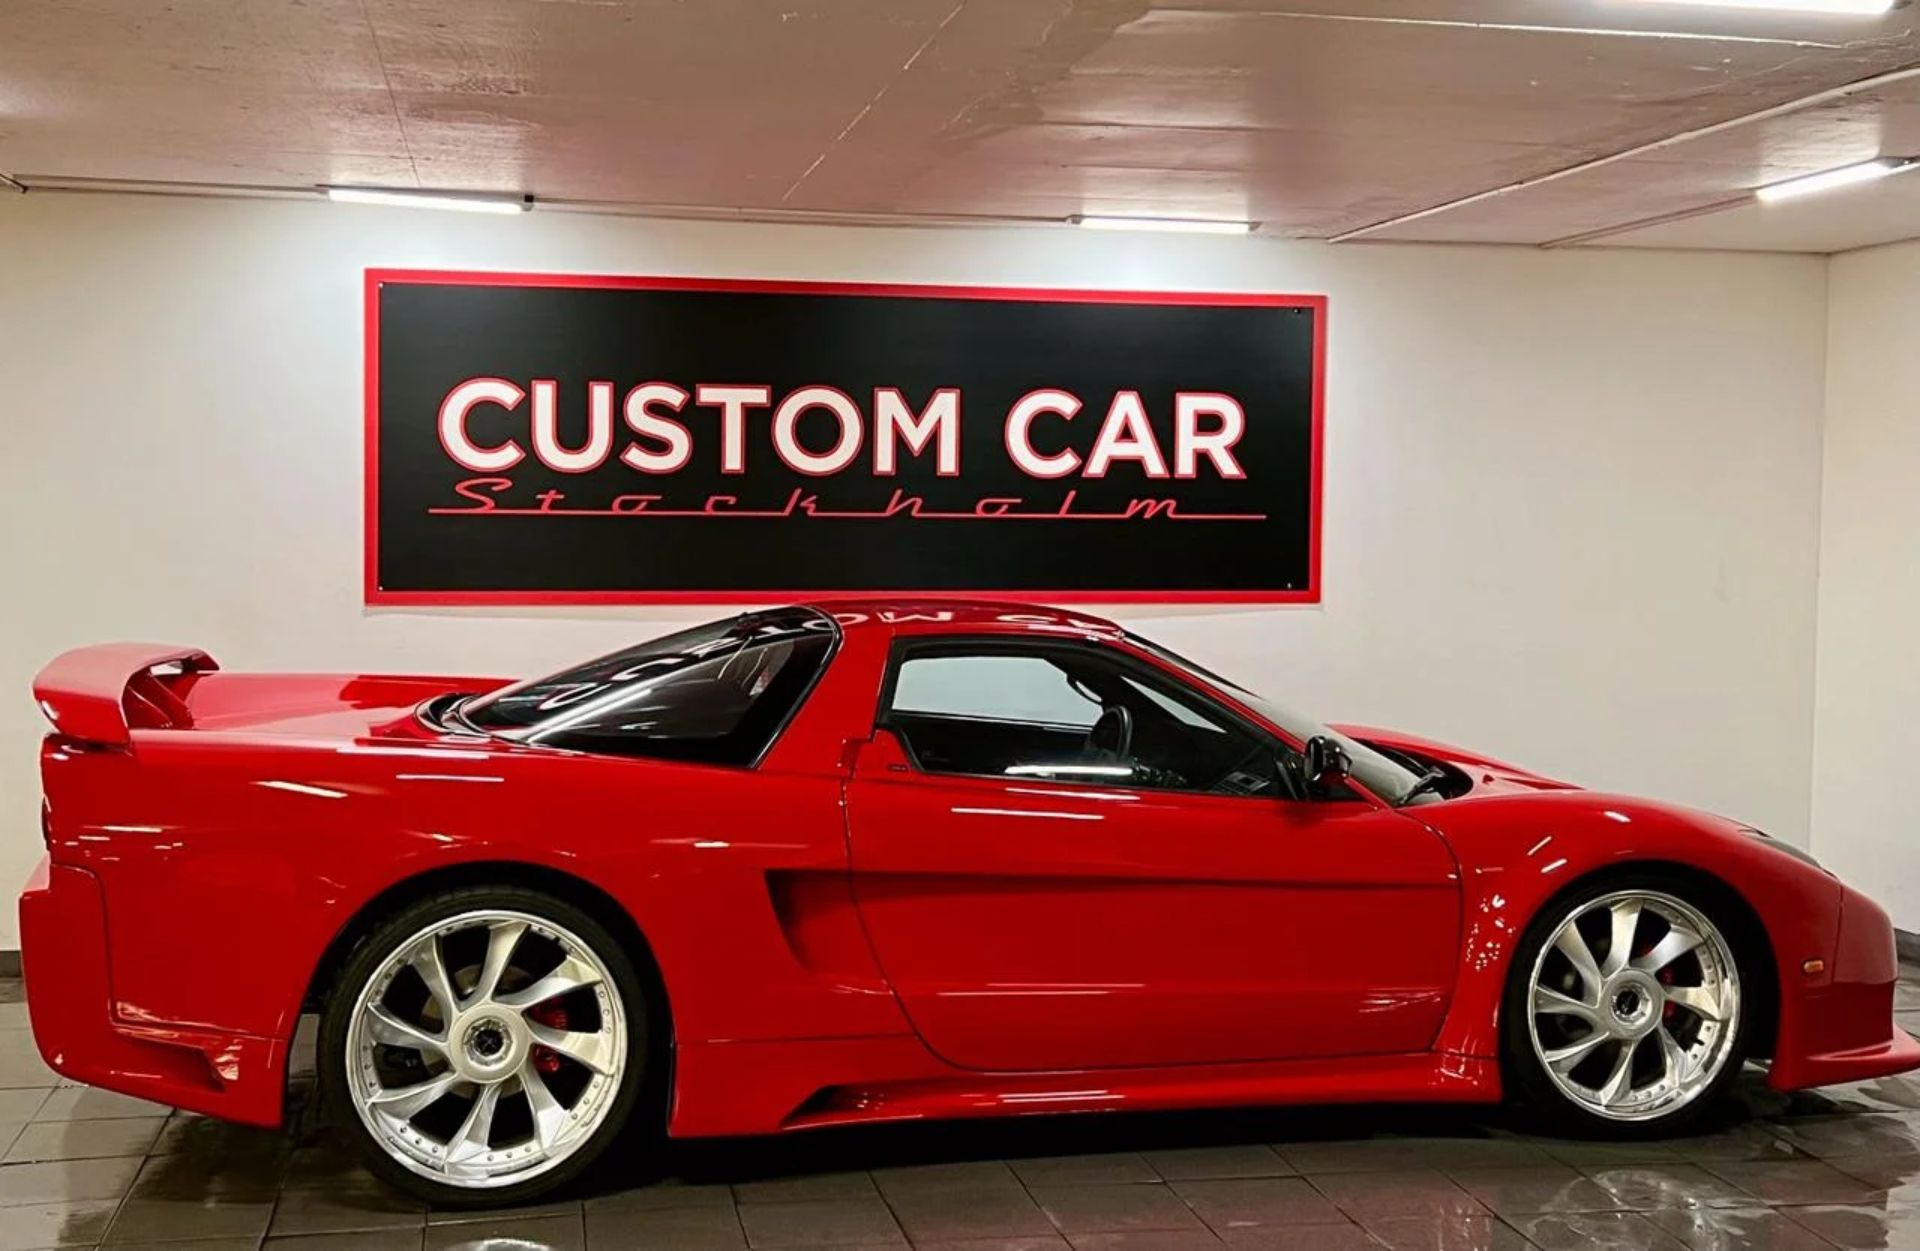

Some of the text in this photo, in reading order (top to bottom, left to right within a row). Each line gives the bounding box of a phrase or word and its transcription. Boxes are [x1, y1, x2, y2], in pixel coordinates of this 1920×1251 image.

[437, 376, 1248, 479] CUSTOM CAR
[454, 477, 1178, 520] Stockholm
